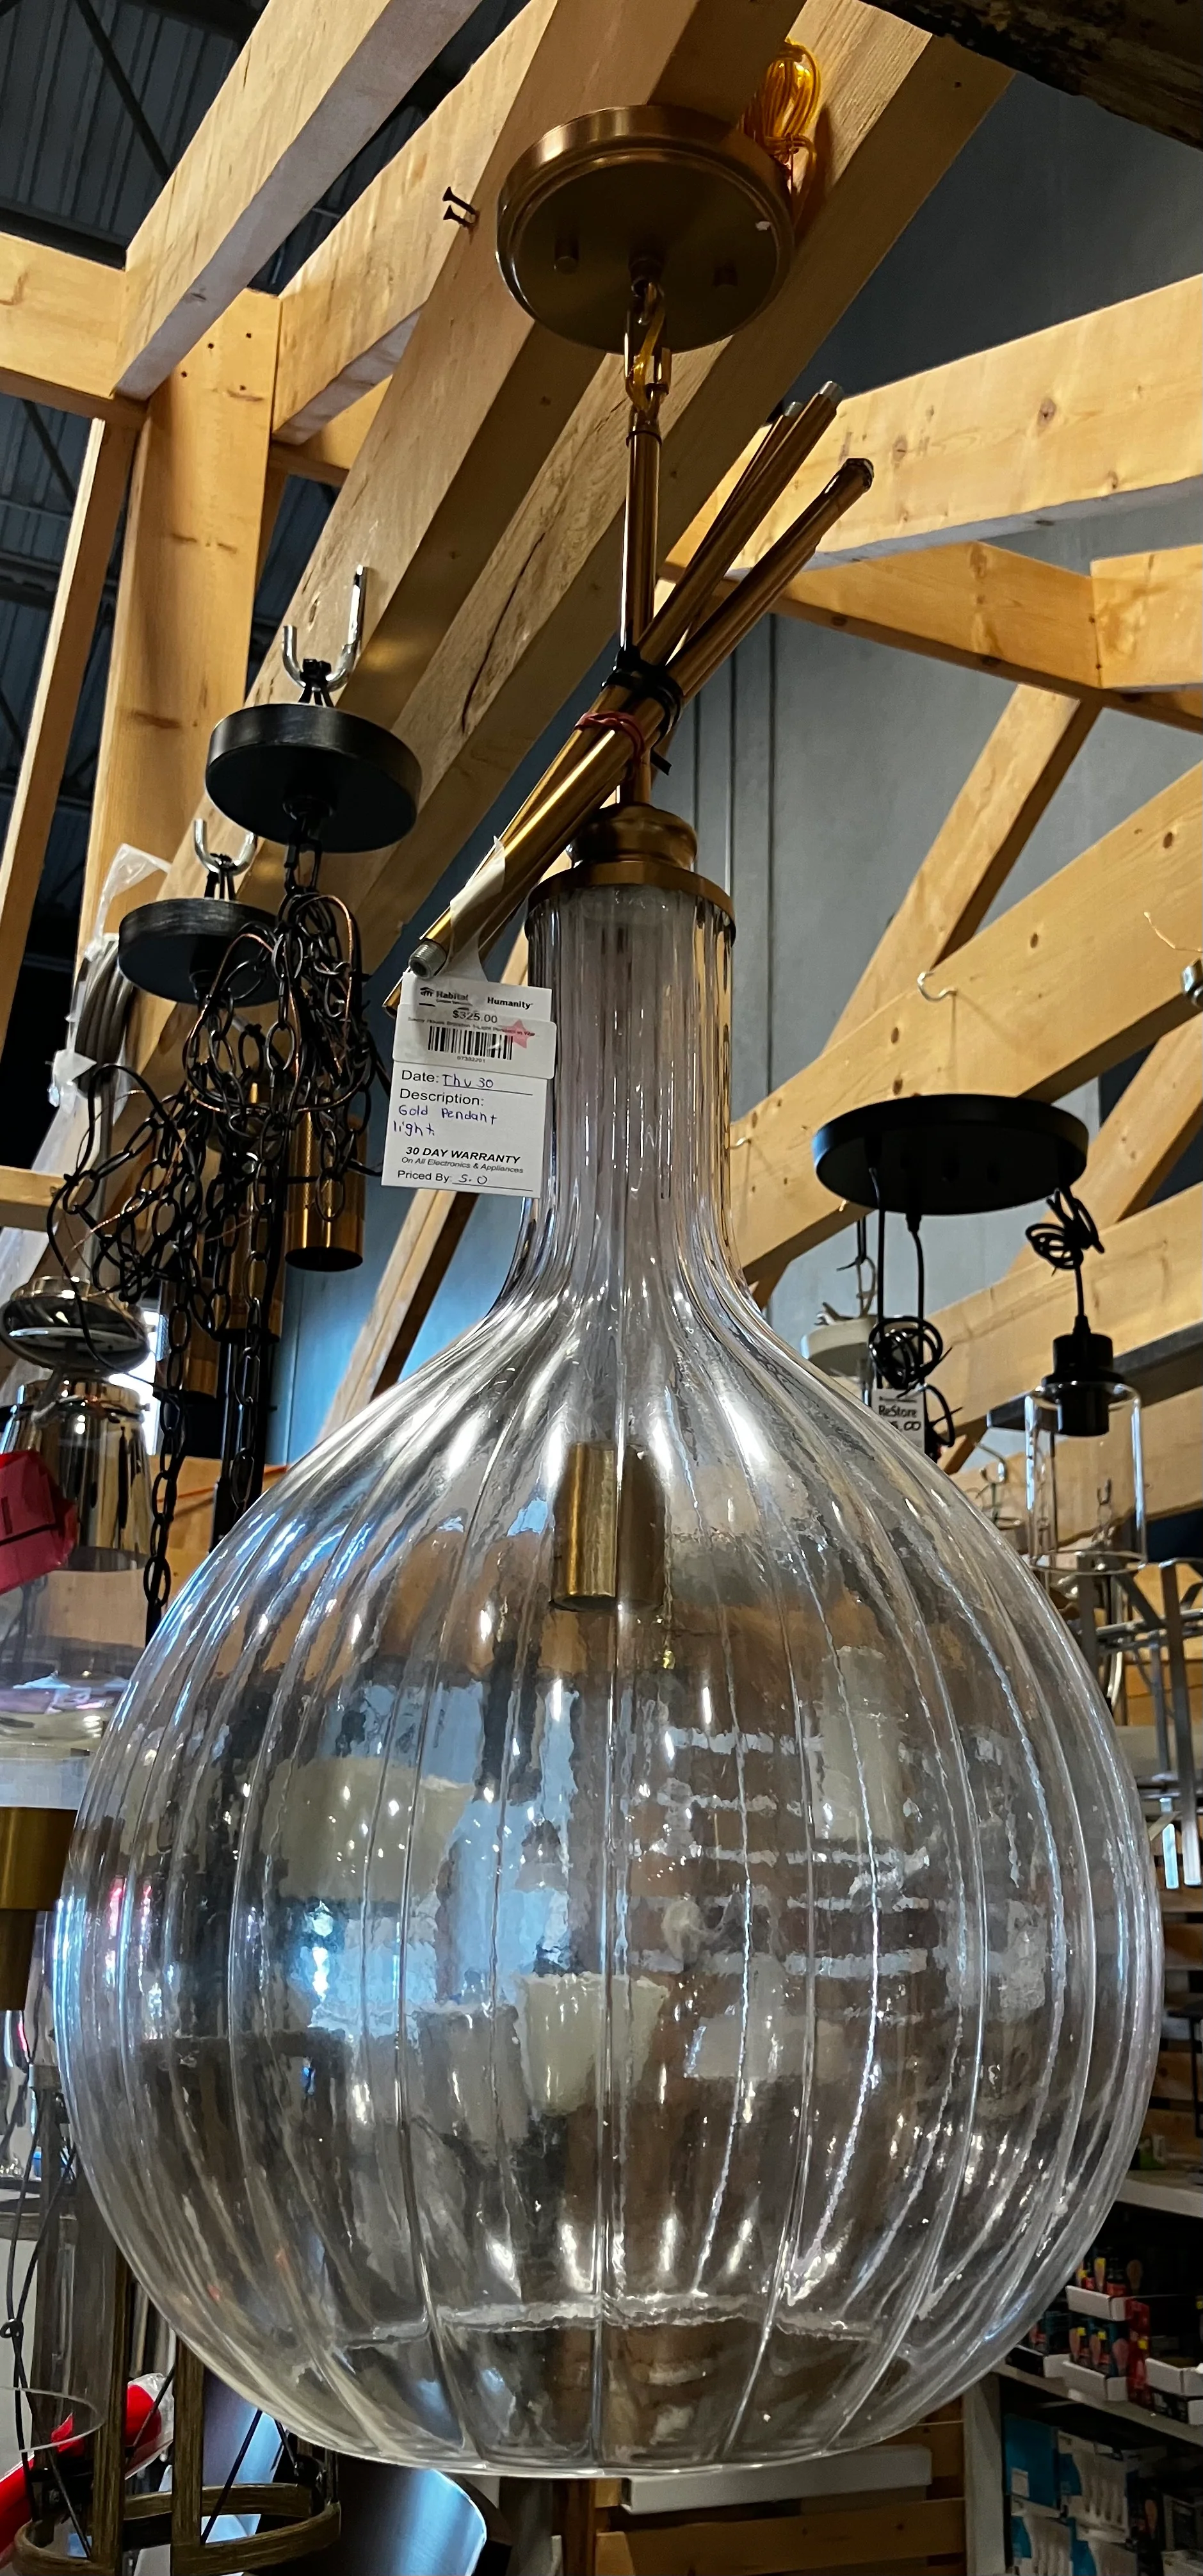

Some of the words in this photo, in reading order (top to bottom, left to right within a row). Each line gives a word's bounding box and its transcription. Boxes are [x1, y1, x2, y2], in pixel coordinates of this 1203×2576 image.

[487, 996, 531, 1010] Humanity
[453, 1010, 497, 1023] $325.00
[401, 1070, 439, 1083] Date:
[478, 1077, 494, 1088] 30
[400, 1089, 485, 1106] Description:
[398, 1105, 428, 1116] Gold
[441, 1107, 497, 1125] Pendant
[405, 1146, 420, 1155] 30
[423, 1147, 448, 1157] DAY
[451, 1150, 521, 1164] WARRANTY
[427, 1159, 471, 1169] Electronics
[480, 1163, 524, 1174] Appliances
[397, 1170, 432, 1181] Priced
[878, 1404, 917, 1418] ReStore
